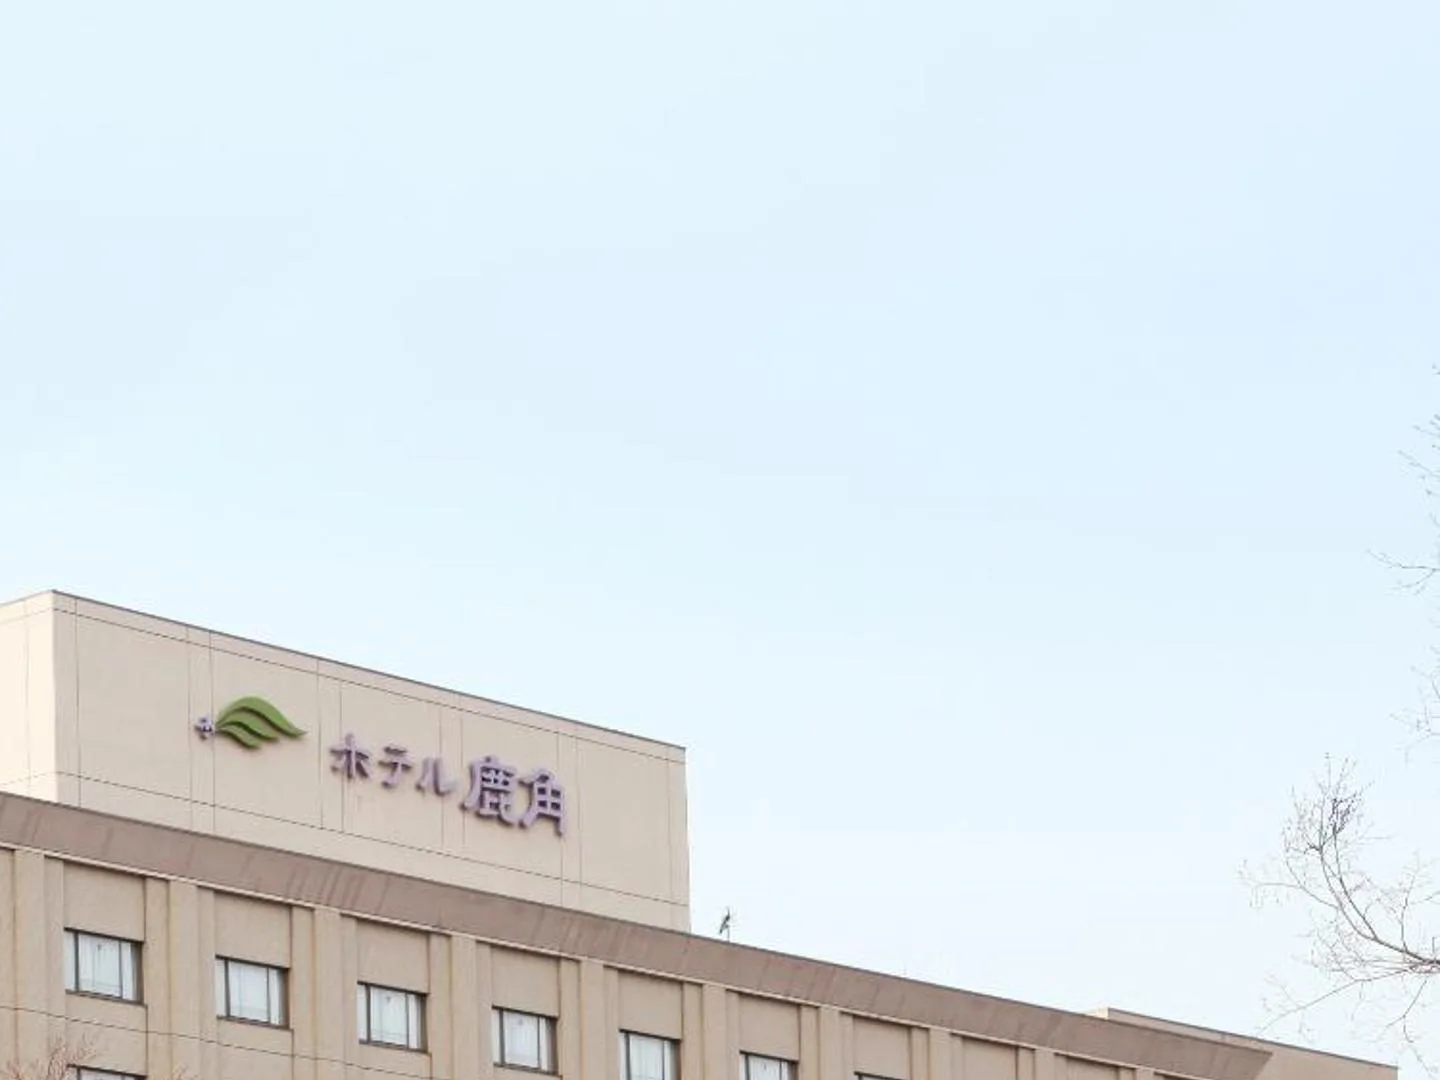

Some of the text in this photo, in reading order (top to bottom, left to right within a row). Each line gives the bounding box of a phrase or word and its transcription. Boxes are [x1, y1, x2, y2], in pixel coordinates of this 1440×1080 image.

[329, 734, 566, 836] ホテル鹿角
